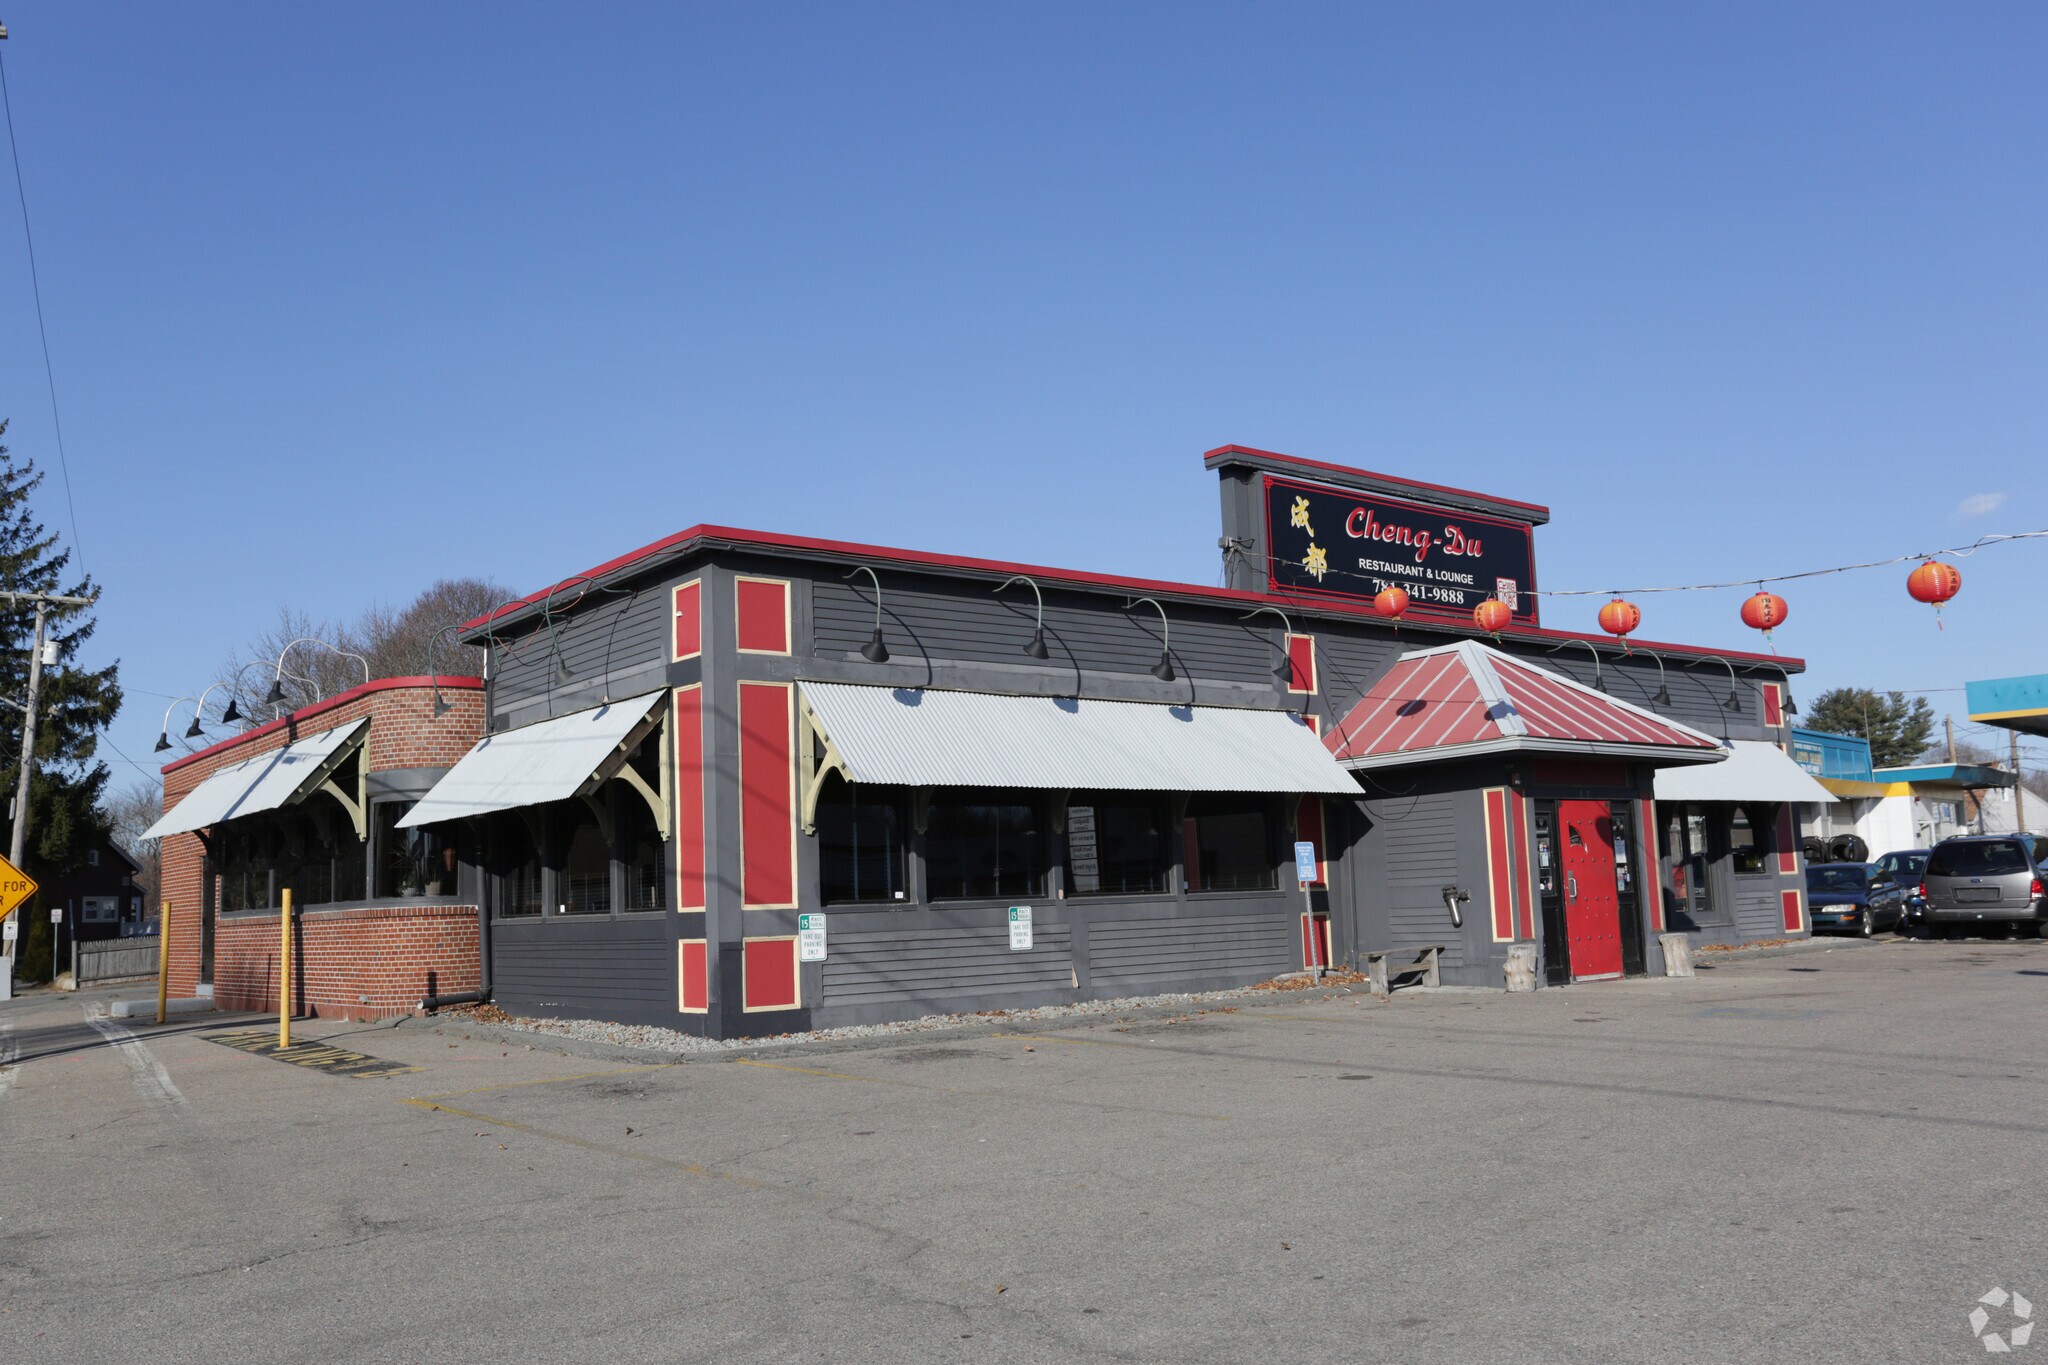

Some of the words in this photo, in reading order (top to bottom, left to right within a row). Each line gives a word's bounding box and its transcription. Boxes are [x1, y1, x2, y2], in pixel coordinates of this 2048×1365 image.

[1346, 507, 1483, 562] Cheng-Du
[1359, 558, 1424, 578] RESTAURANT
[1426, 568, 1433, 579] &
[1435, 569, 1474, 585] LOUNGE
[4, 881, 27, 892] FOR
[1011, 911, 1017, 920] 15
[801, 919, 809, 929] 15
